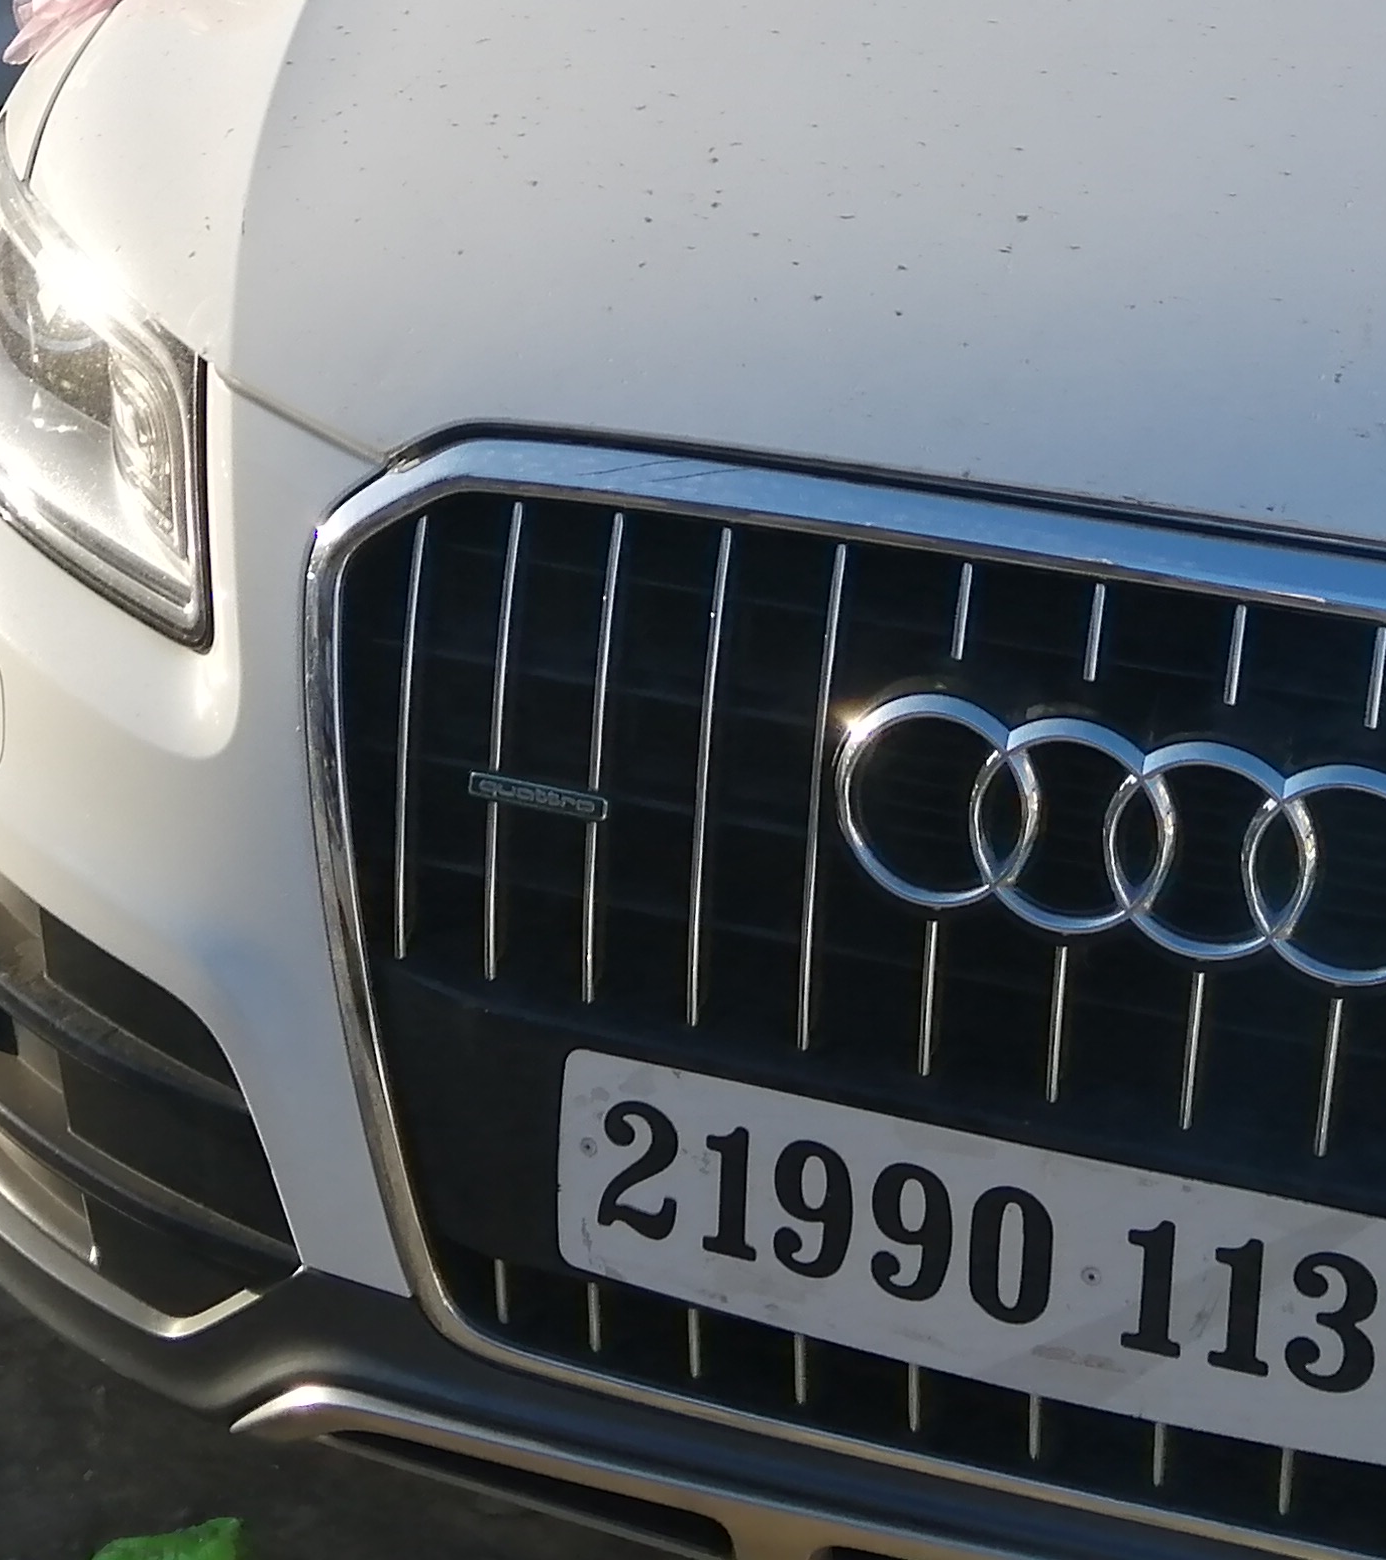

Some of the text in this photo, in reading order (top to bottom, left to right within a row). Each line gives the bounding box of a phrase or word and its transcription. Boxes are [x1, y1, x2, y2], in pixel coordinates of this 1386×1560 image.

[478, 779, 596, 813] quattro
[596, 1100, 1056, 1326] 21990
[1120, 1220, 1380, 1394] 113
